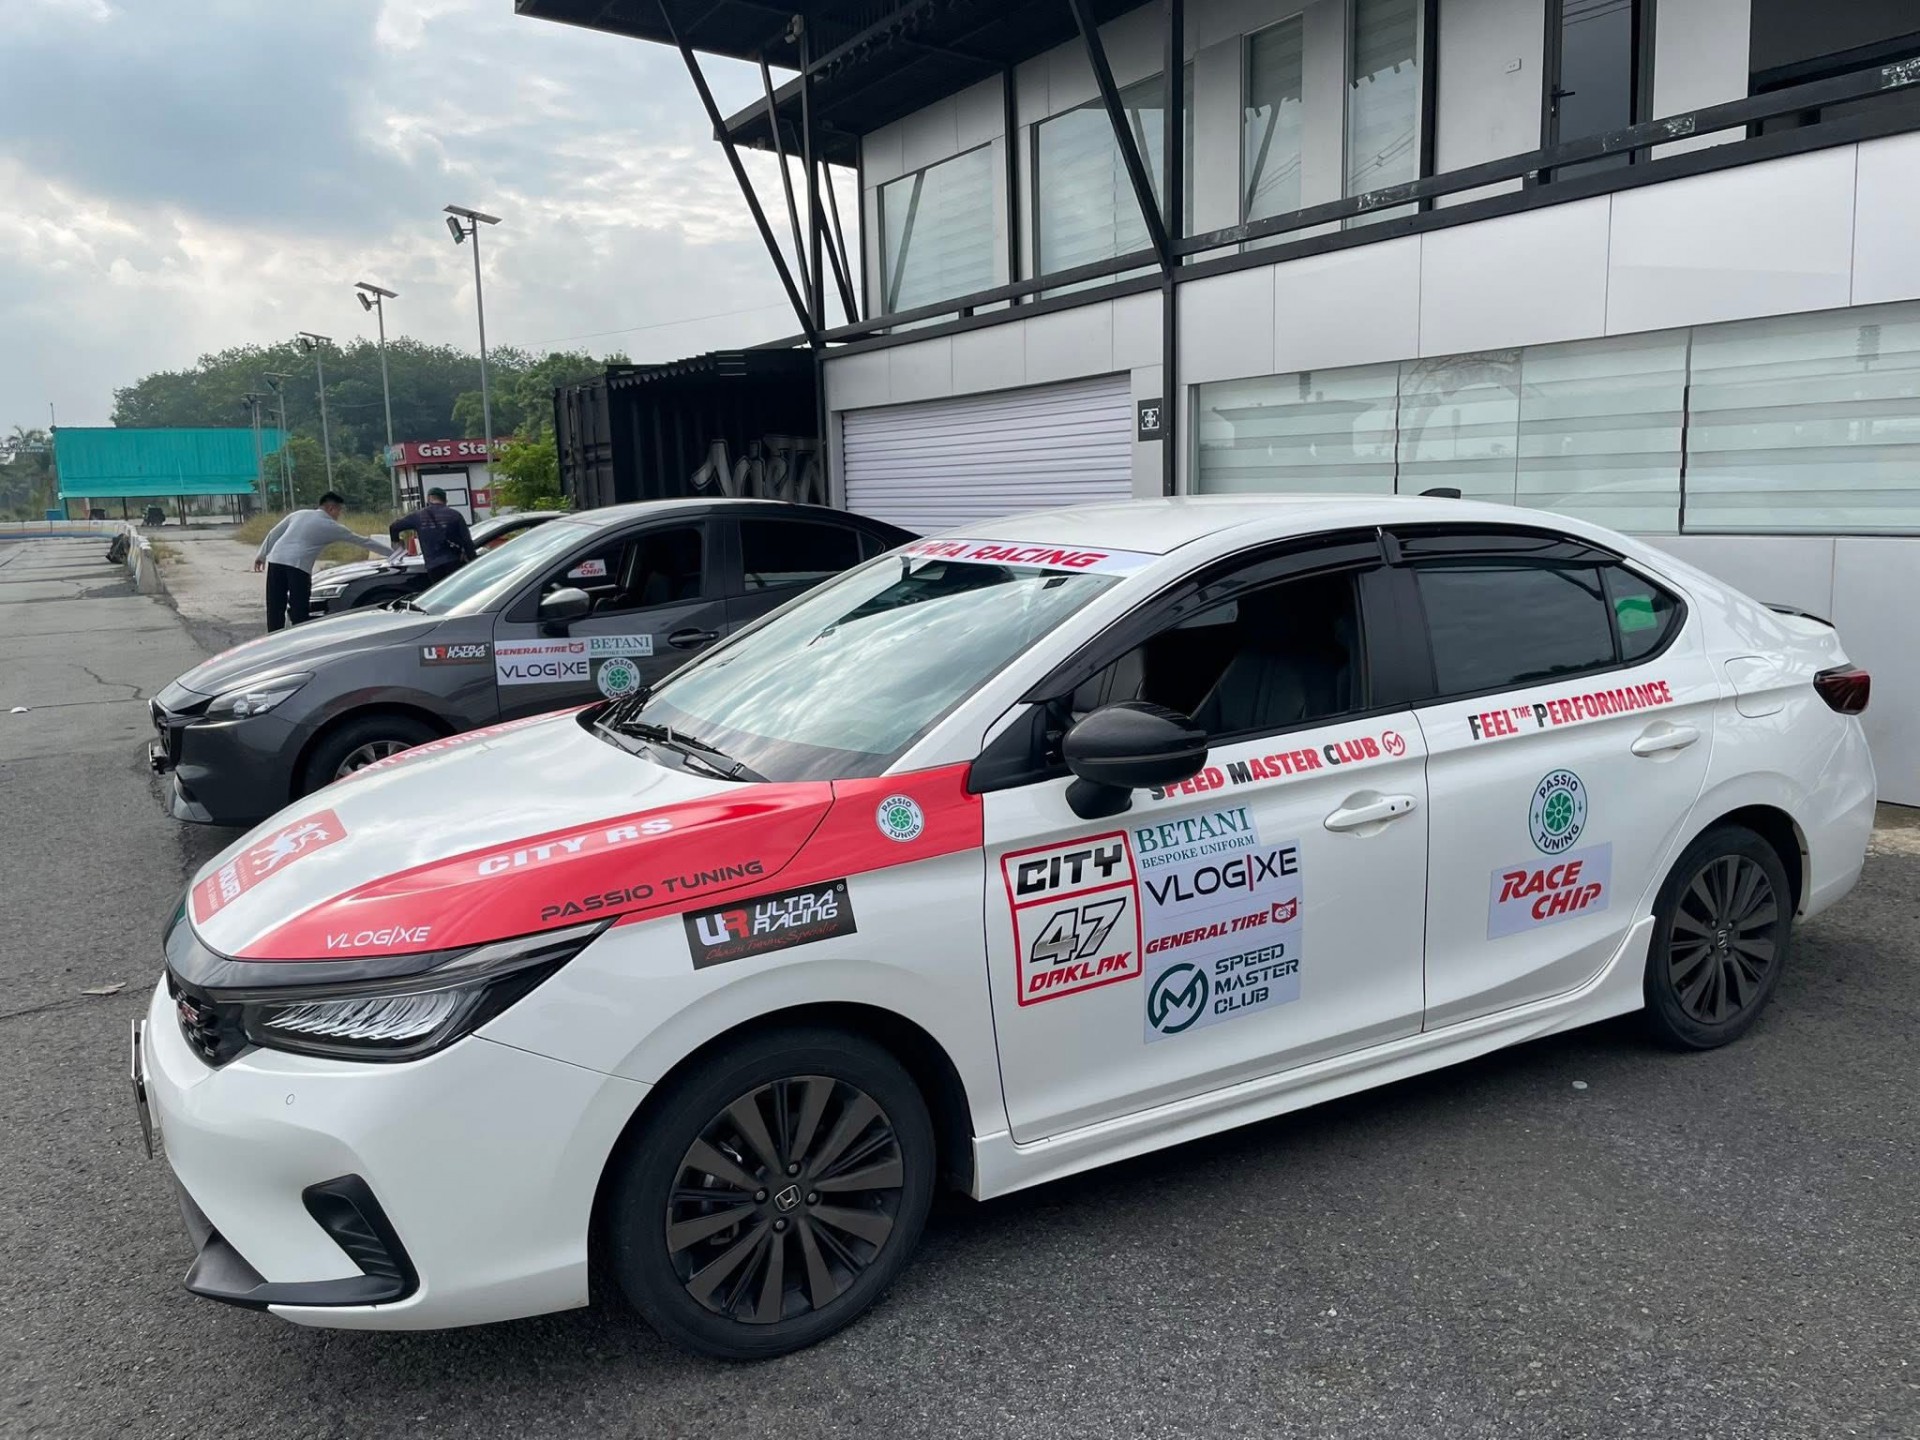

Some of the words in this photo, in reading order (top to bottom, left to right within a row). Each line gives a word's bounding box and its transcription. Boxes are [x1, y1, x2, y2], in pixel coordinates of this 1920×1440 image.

[418, 444, 451, 457] Gas
[458, 440, 510, 455] Staio
[964, 545, 1110, 568] RACING
[495, 646, 544, 656] GENERAL
[545, 645, 567, 654] TIRE
[591, 636, 651, 649] BETANI
[604, 659, 633, 671] PASSIO
[1467, 709, 1519, 740] FEEL
[1512, 705, 1533, 720] THE
[1532, 680, 1674, 728] PERFORMANCE
[1226, 748, 1323, 785] MASTER
[1323, 736, 1380, 766] CLUB
[1538, 773, 1579, 799] PASSIO
[881, 797, 912, 812] PASSIO
[478, 835, 589, 877] CITY
[605, 817, 674, 844] RS
[889, 824, 920, 838] TUNING
[1134, 807, 1252, 854] BETANI
[1537, 823, 1580, 850] TUNING
[1141, 847, 1199, 870] BESPOKE
[1200, 834, 1255, 856] UNIFORM
[1016, 844, 1124, 896] CITY
[1497, 860, 1584, 904] RACE
[541, 883, 654, 922] PASSIO
[660, 860, 764, 893] TUNING
[755, 889, 834, 920] ULTRA
[1531, 882, 1602, 921] CHIP
[753, 902, 838, 935] RACING
[1029, 896, 1128, 966] 47
[1145, 921, 1231, 955] GENERAL
[1231, 910, 1270, 932] TIRE
[1028, 951, 1133, 993] DAKLAK
[1215, 942, 1285, 976] SPEED
[1214, 958, 1300, 996] MASTER
[1213, 986, 1270, 1015] CLUB
